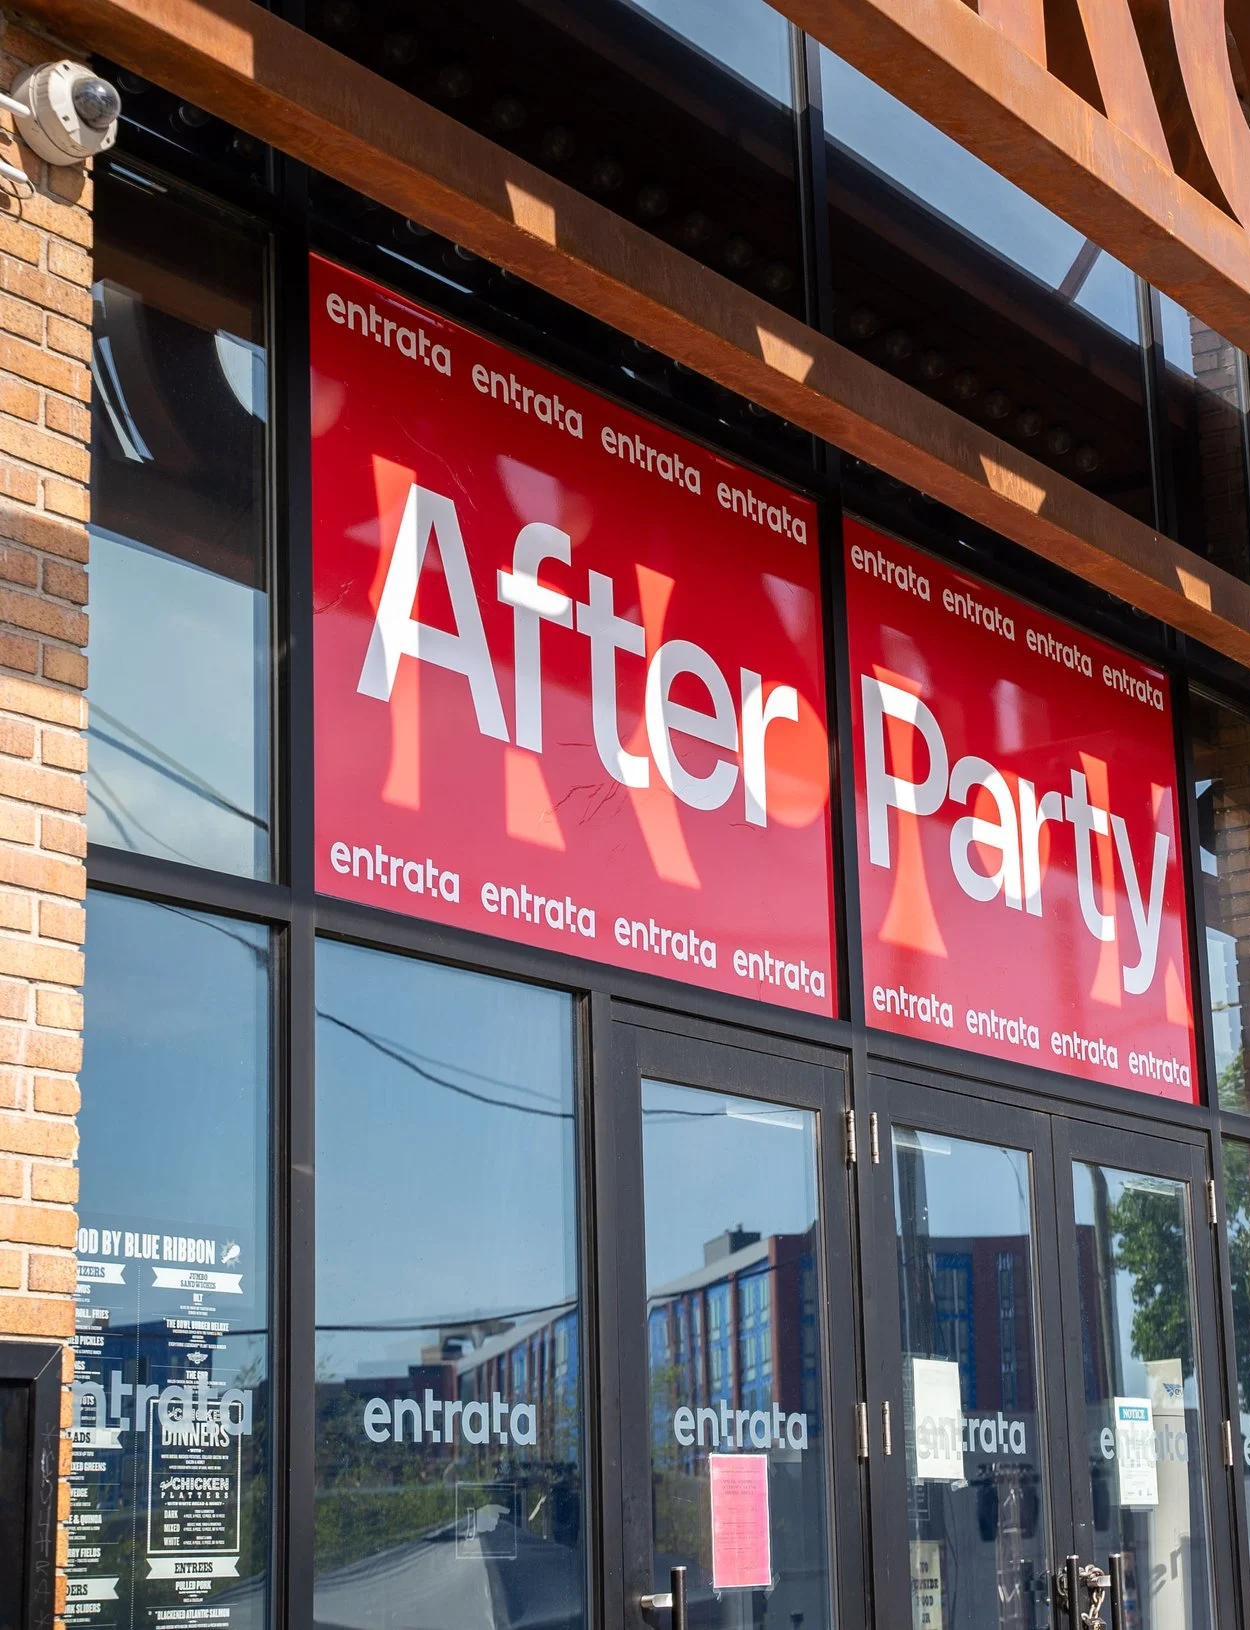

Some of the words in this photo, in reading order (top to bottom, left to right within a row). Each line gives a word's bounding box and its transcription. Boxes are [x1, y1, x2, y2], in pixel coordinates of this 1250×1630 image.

[327, 293, 452, 376] entrata
[472, 364, 583, 439] entrata
[601, 426, 701, 495] entrata
[717, 482, 807, 544] entrata
[851, 544, 930, 601] entrata
[942, 587, 1015, 641] entrata
[1026, 628, 1092, 677] entrata
[1103, 663, 1164, 711] entrata
[356, 482, 799, 828] After
[861, 674, 1170, 994] Party
[330, 841, 460, 902] entrata
[481, 882, 596, 938] entrata
[615, 915, 717, 969] entrata
[733, 949, 826, 998] entrata
[873, 984, 954, 1028] entrata
[966, 1008, 1040, 1050] entrata
[1051, 1030, 1118, 1070] entrata
[1128, 1050, 1190, 1087] entrata
[72, 1228, 99, 1254] OD
[102, 1230, 122, 1257] BY
[125, 1232, 160, 1260] BLUE
[163, 1236, 216, 1265] RIBBON
[189, 1272, 208, 1281] JUMBO
[80, 1335, 104, 1346] PICKLES
[72, 1370, 252, 1435] ntrata
[364, 1389, 537, 1445] entrata
[1122, 1408, 1145, 1419] NOTICE
[162, 1423, 230, 1447] DINNERS
[674, 1400, 807, 1449] entrata
[172, 1477, 230, 1491] CHICKEN
[164, 1510, 179, 1519] DARK
[164, 1524, 180, 1533] MIXED
[164, 1537, 180, 1546] WHITE
[175, 1562, 213, 1574] ENTREES
